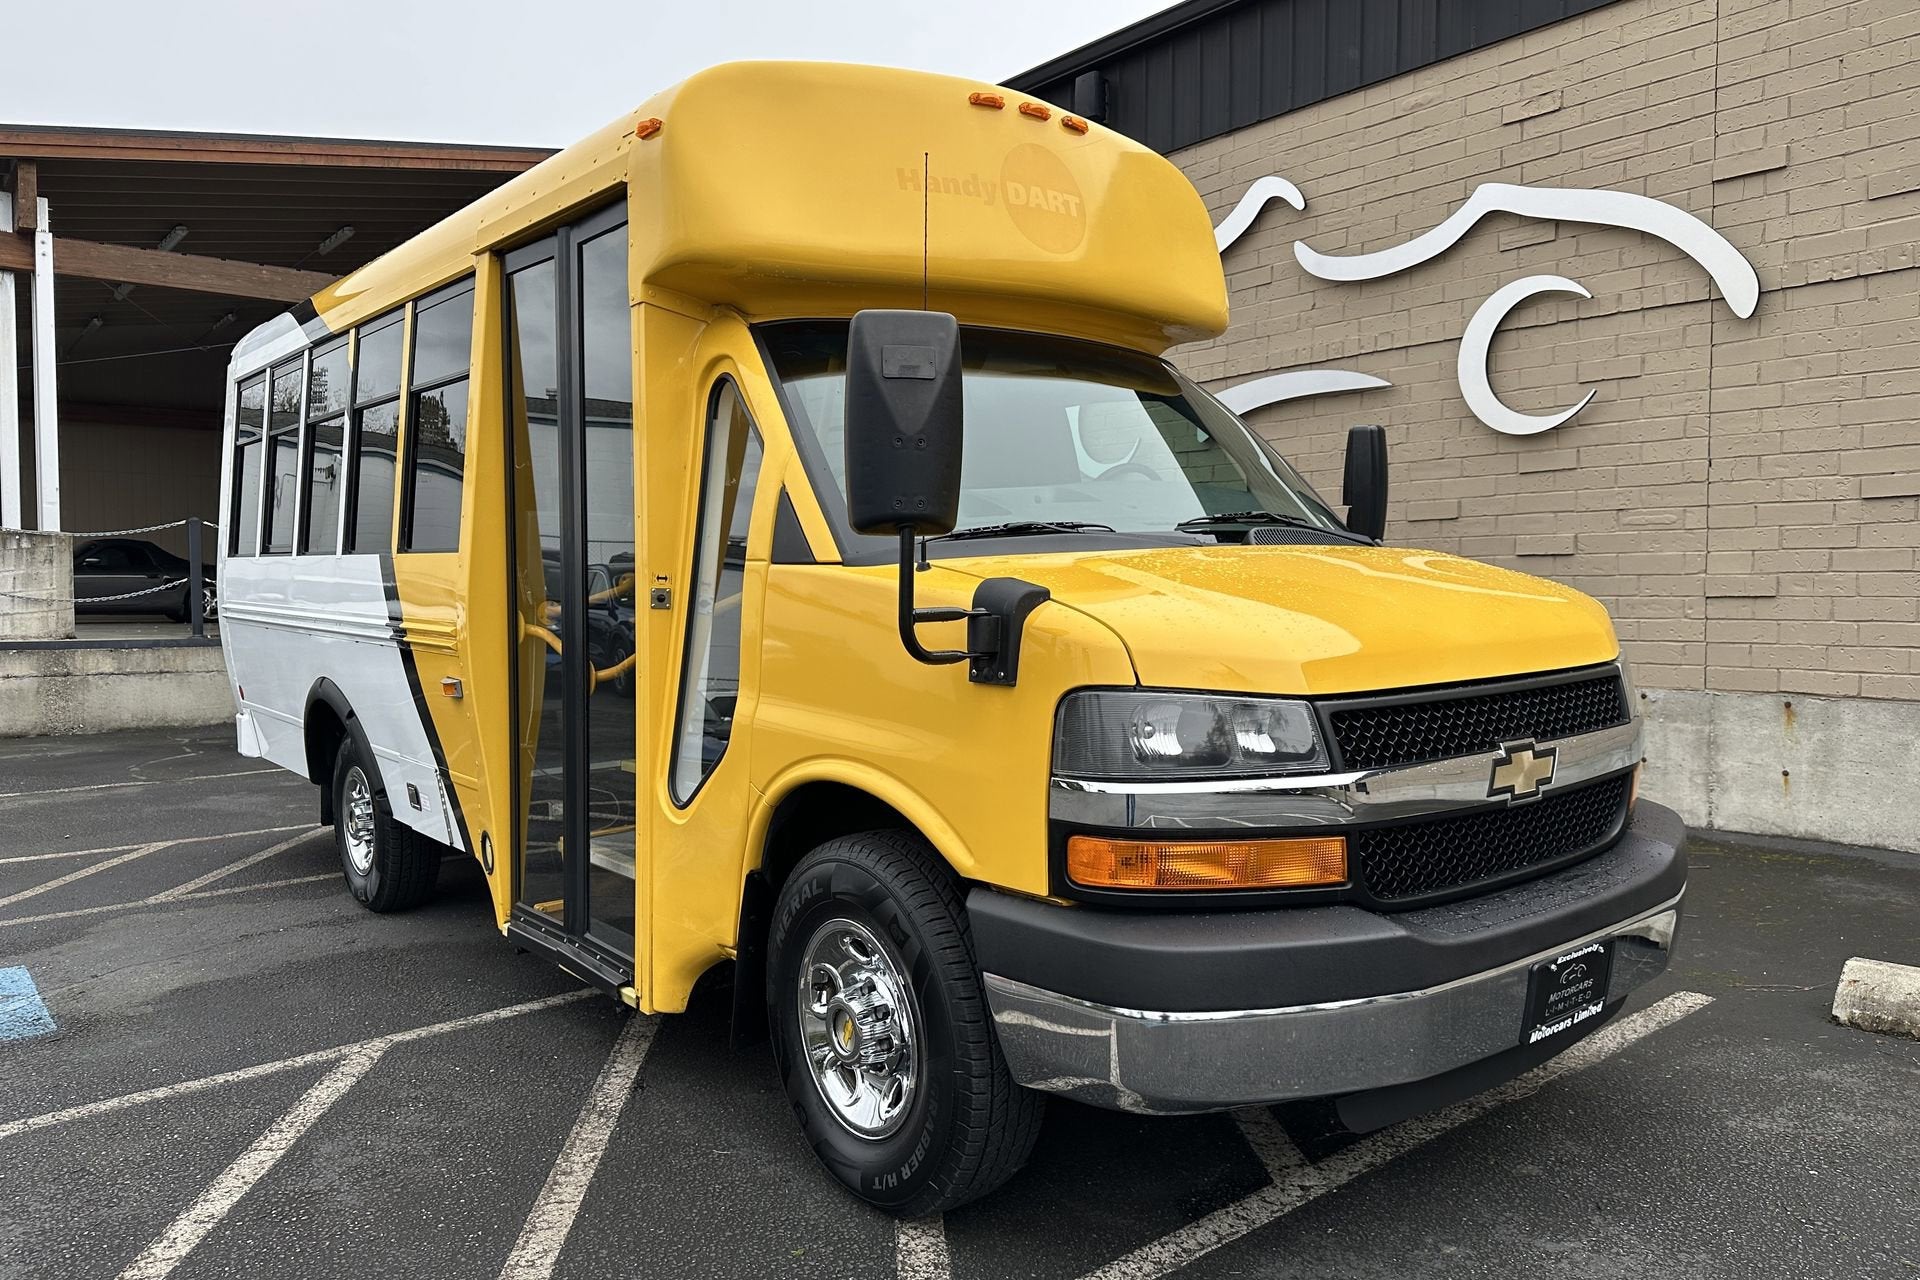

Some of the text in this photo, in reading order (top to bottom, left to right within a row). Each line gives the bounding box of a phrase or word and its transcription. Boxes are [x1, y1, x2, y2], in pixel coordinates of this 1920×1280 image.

[1006, 180, 1080, 217] DART
[774, 877, 824, 951] NERAL
[1556, 943, 1599, 965] Exclusively
[1548, 978, 1594, 1003] MOTORCARS
[1529, 1000, 1603, 1044] Motorcars Limited
